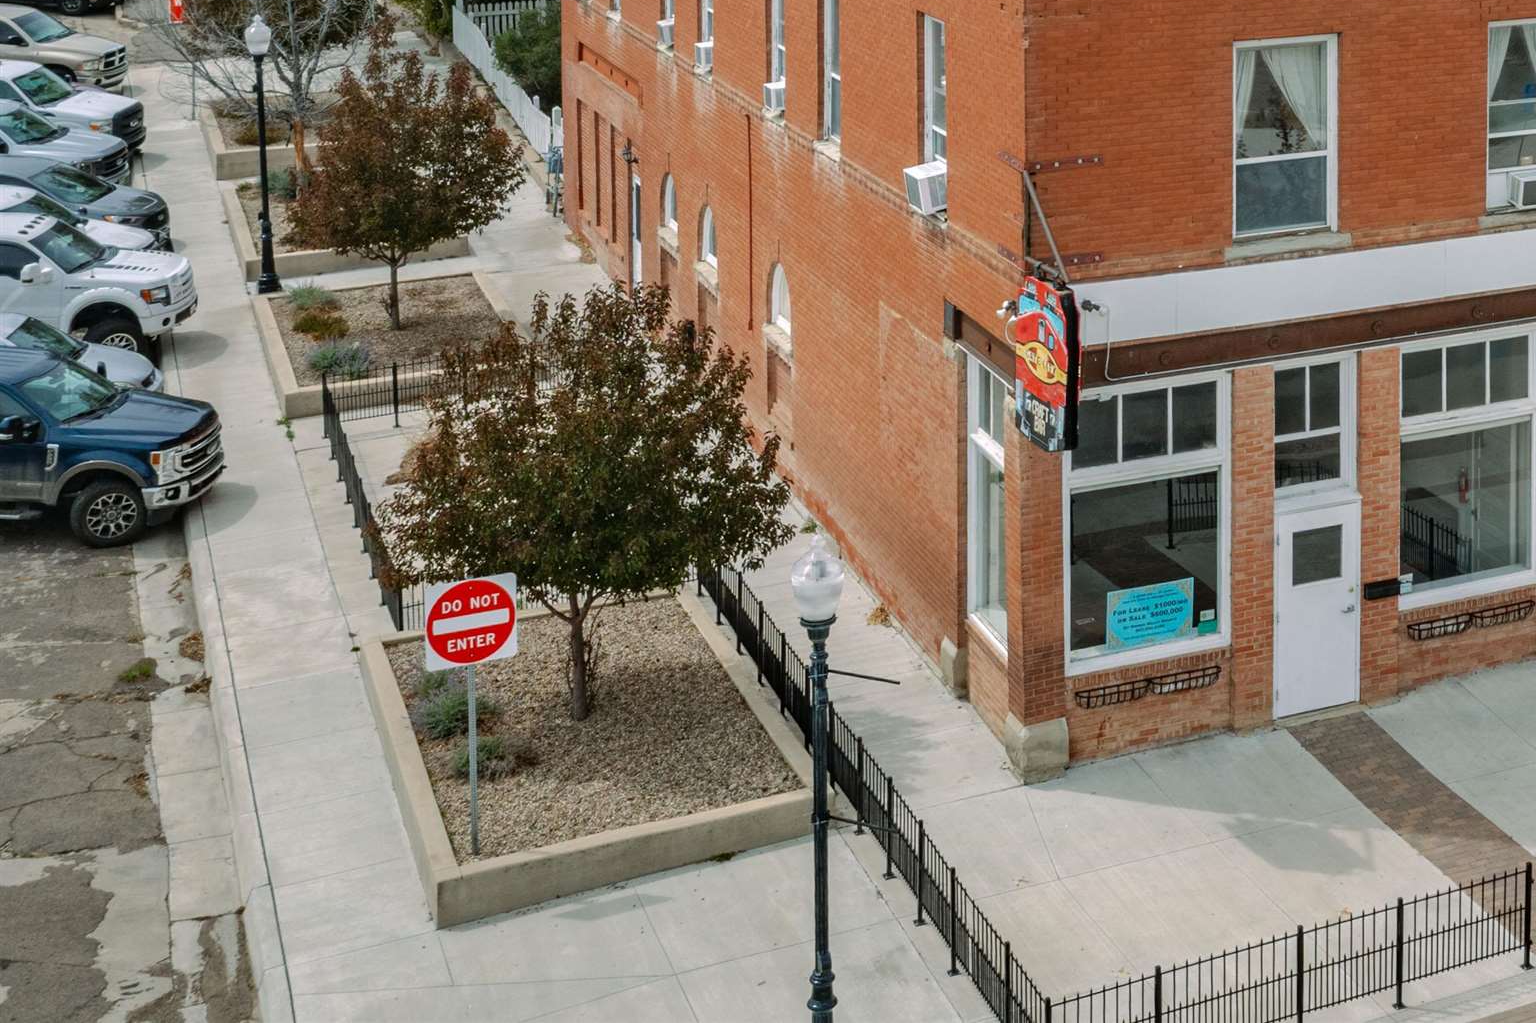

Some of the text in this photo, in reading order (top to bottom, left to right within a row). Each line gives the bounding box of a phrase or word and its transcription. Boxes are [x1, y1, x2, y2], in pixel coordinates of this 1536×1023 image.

[441, 592, 500, 614] DO NOT
[447, 632, 496, 653] ENTER
